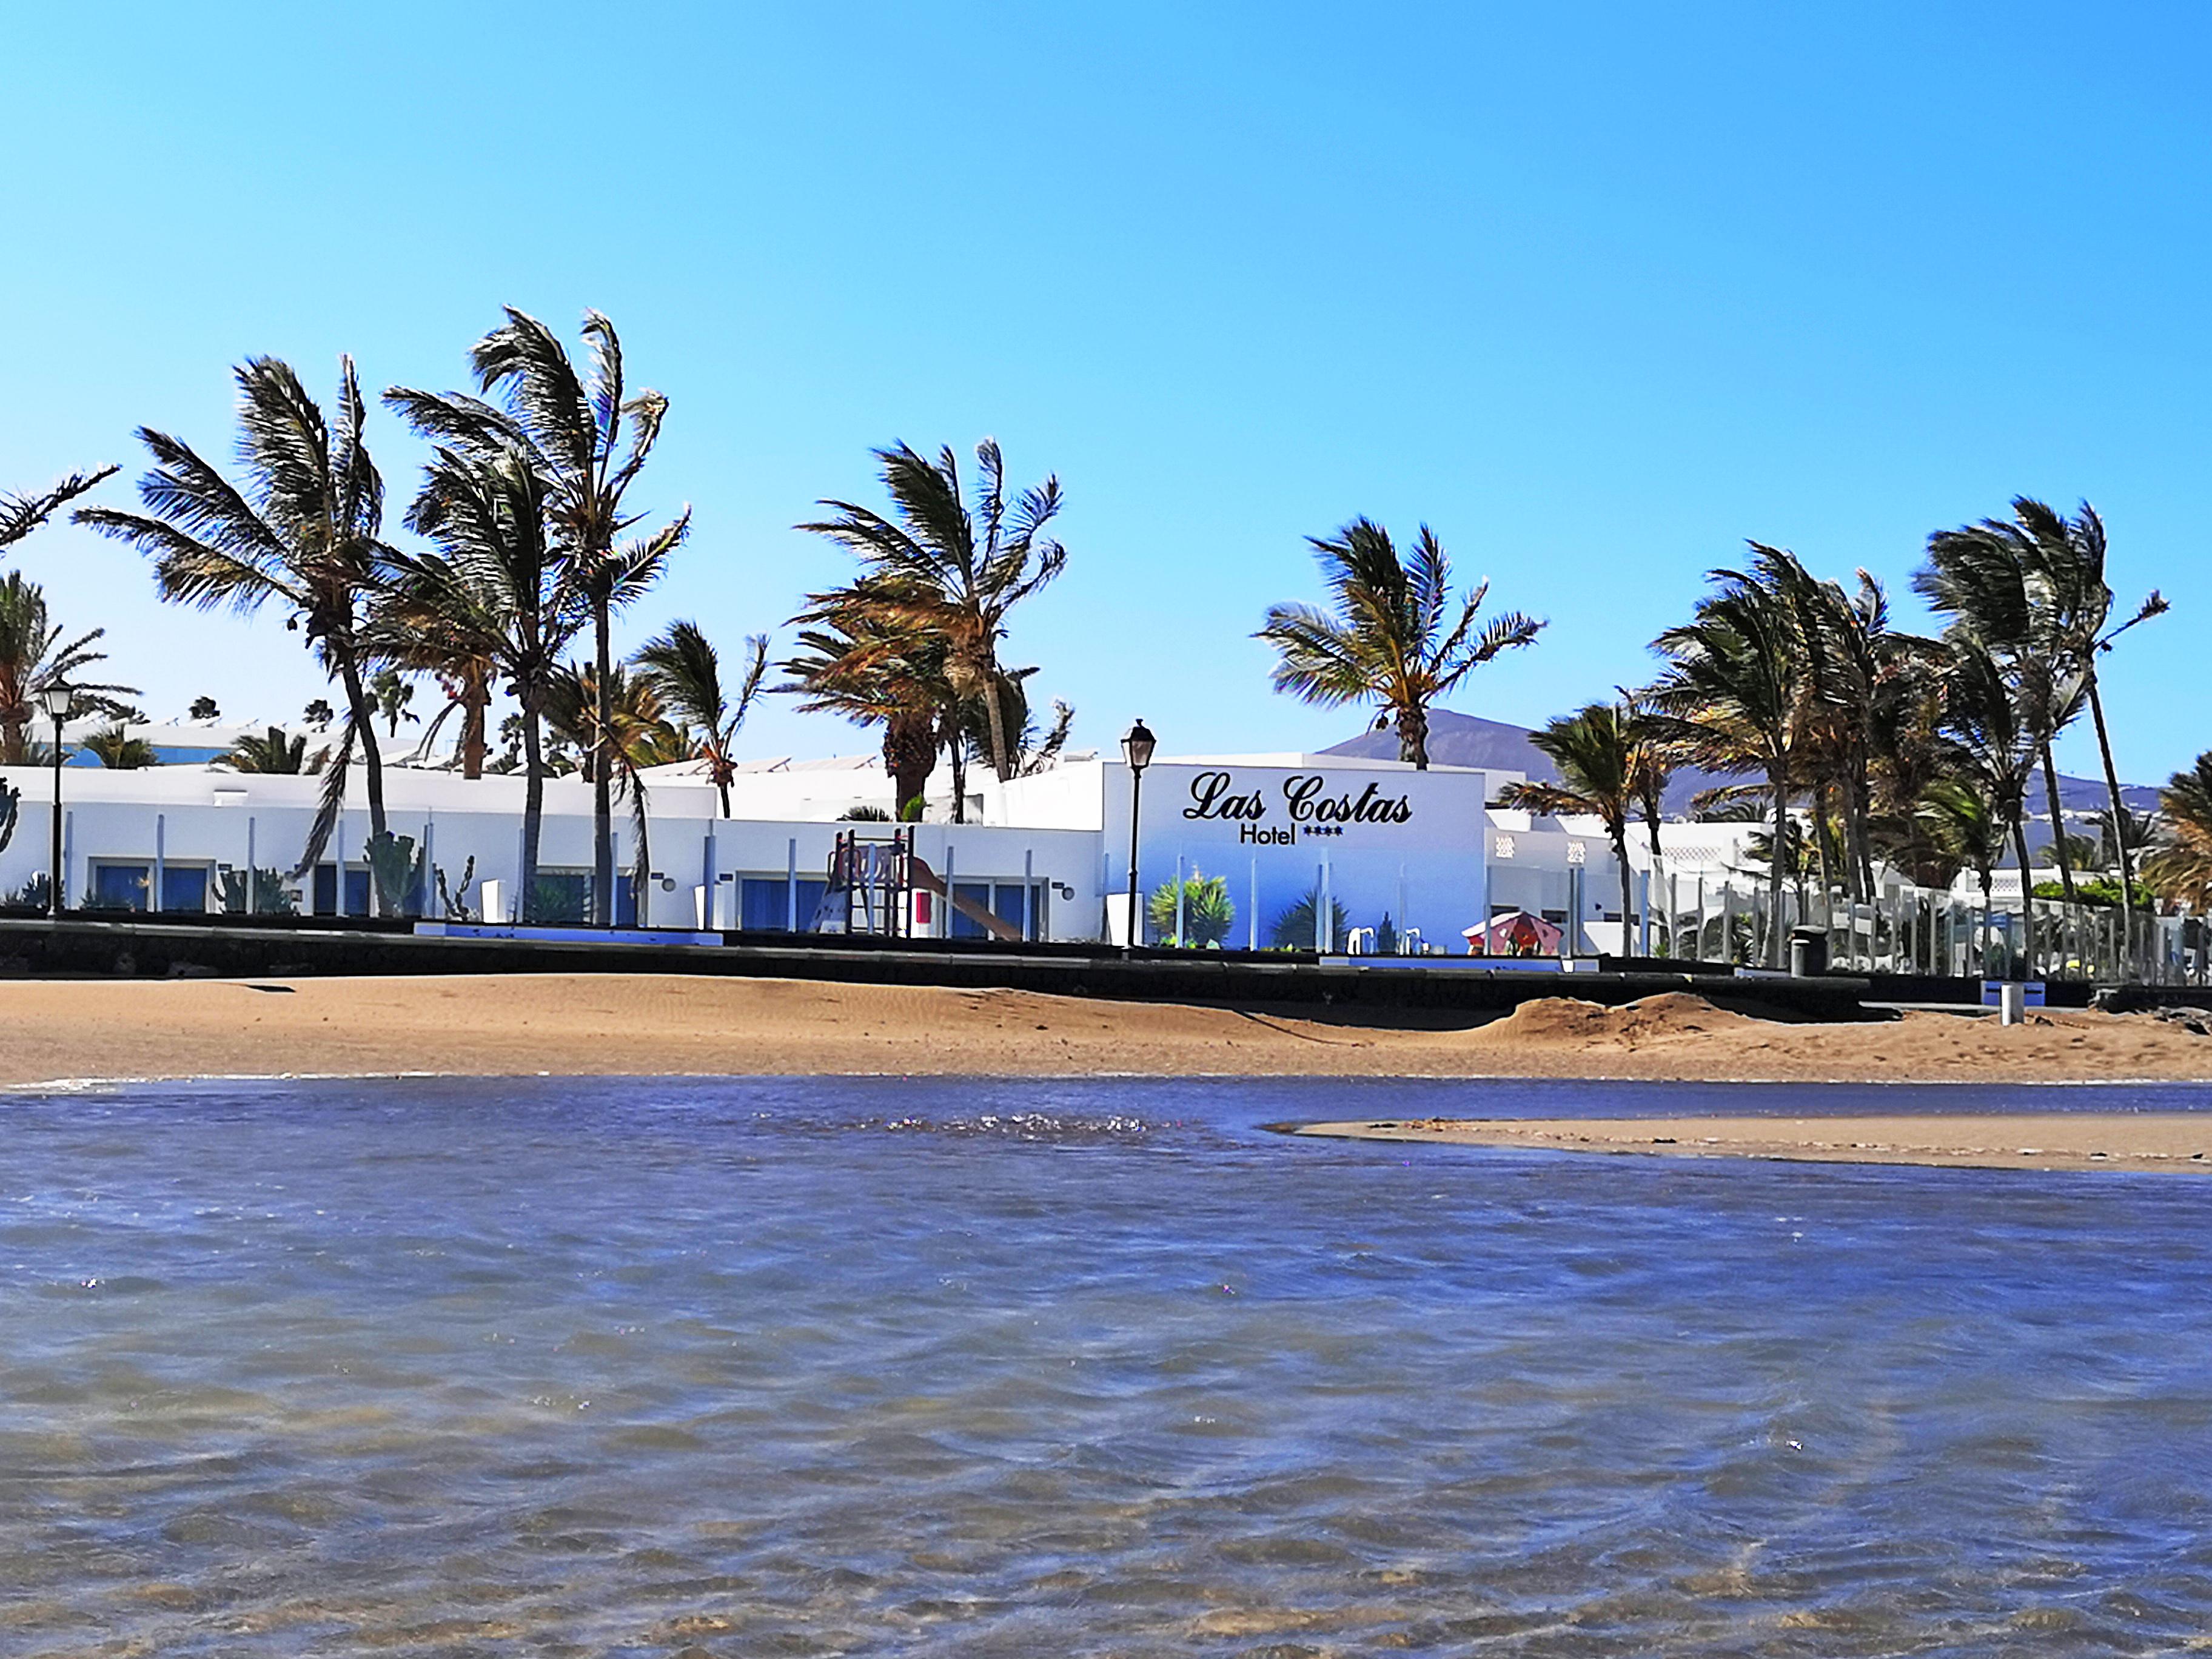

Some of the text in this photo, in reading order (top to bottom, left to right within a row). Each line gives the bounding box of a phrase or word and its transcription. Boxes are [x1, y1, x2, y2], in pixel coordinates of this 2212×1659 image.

[1183, 772, 1412, 823] Las Costas
[1240, 823, 1296, 845] Hotel
